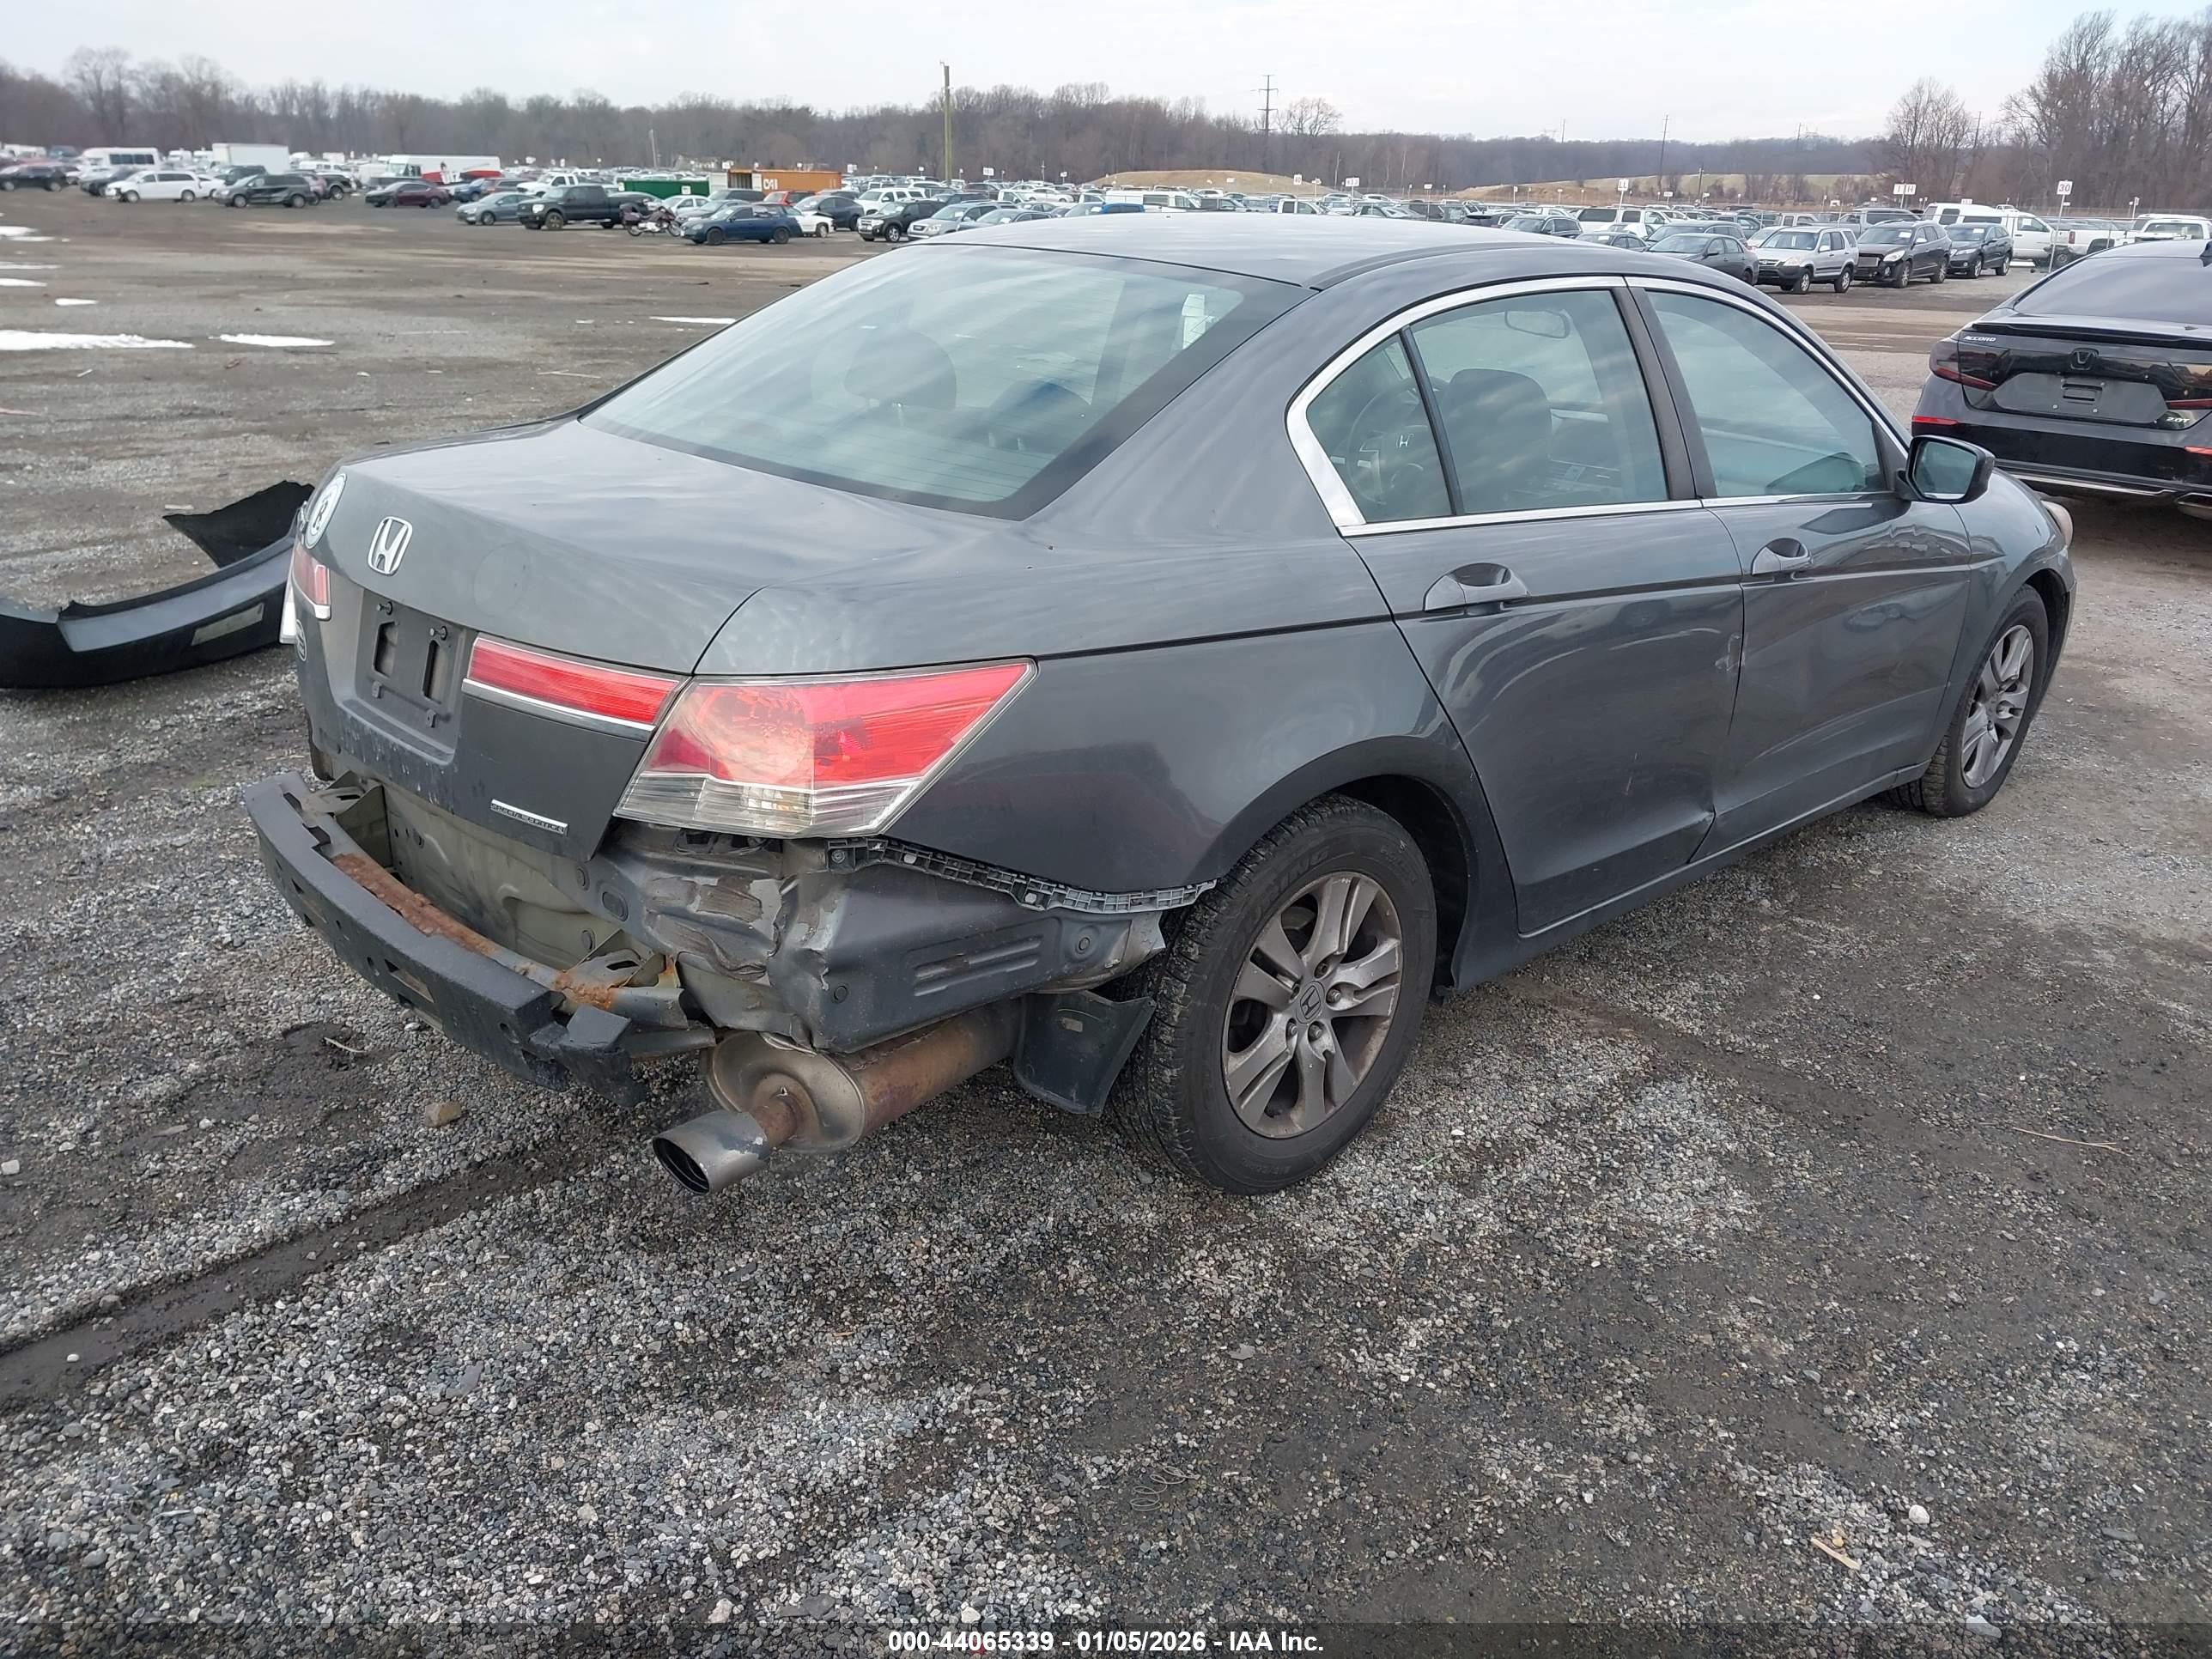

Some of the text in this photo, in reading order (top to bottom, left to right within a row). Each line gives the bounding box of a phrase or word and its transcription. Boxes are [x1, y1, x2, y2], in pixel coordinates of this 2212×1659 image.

[2058, 184, 2070, 192] 30
[490, 803, 565, 834] SPECIAL EDITION
